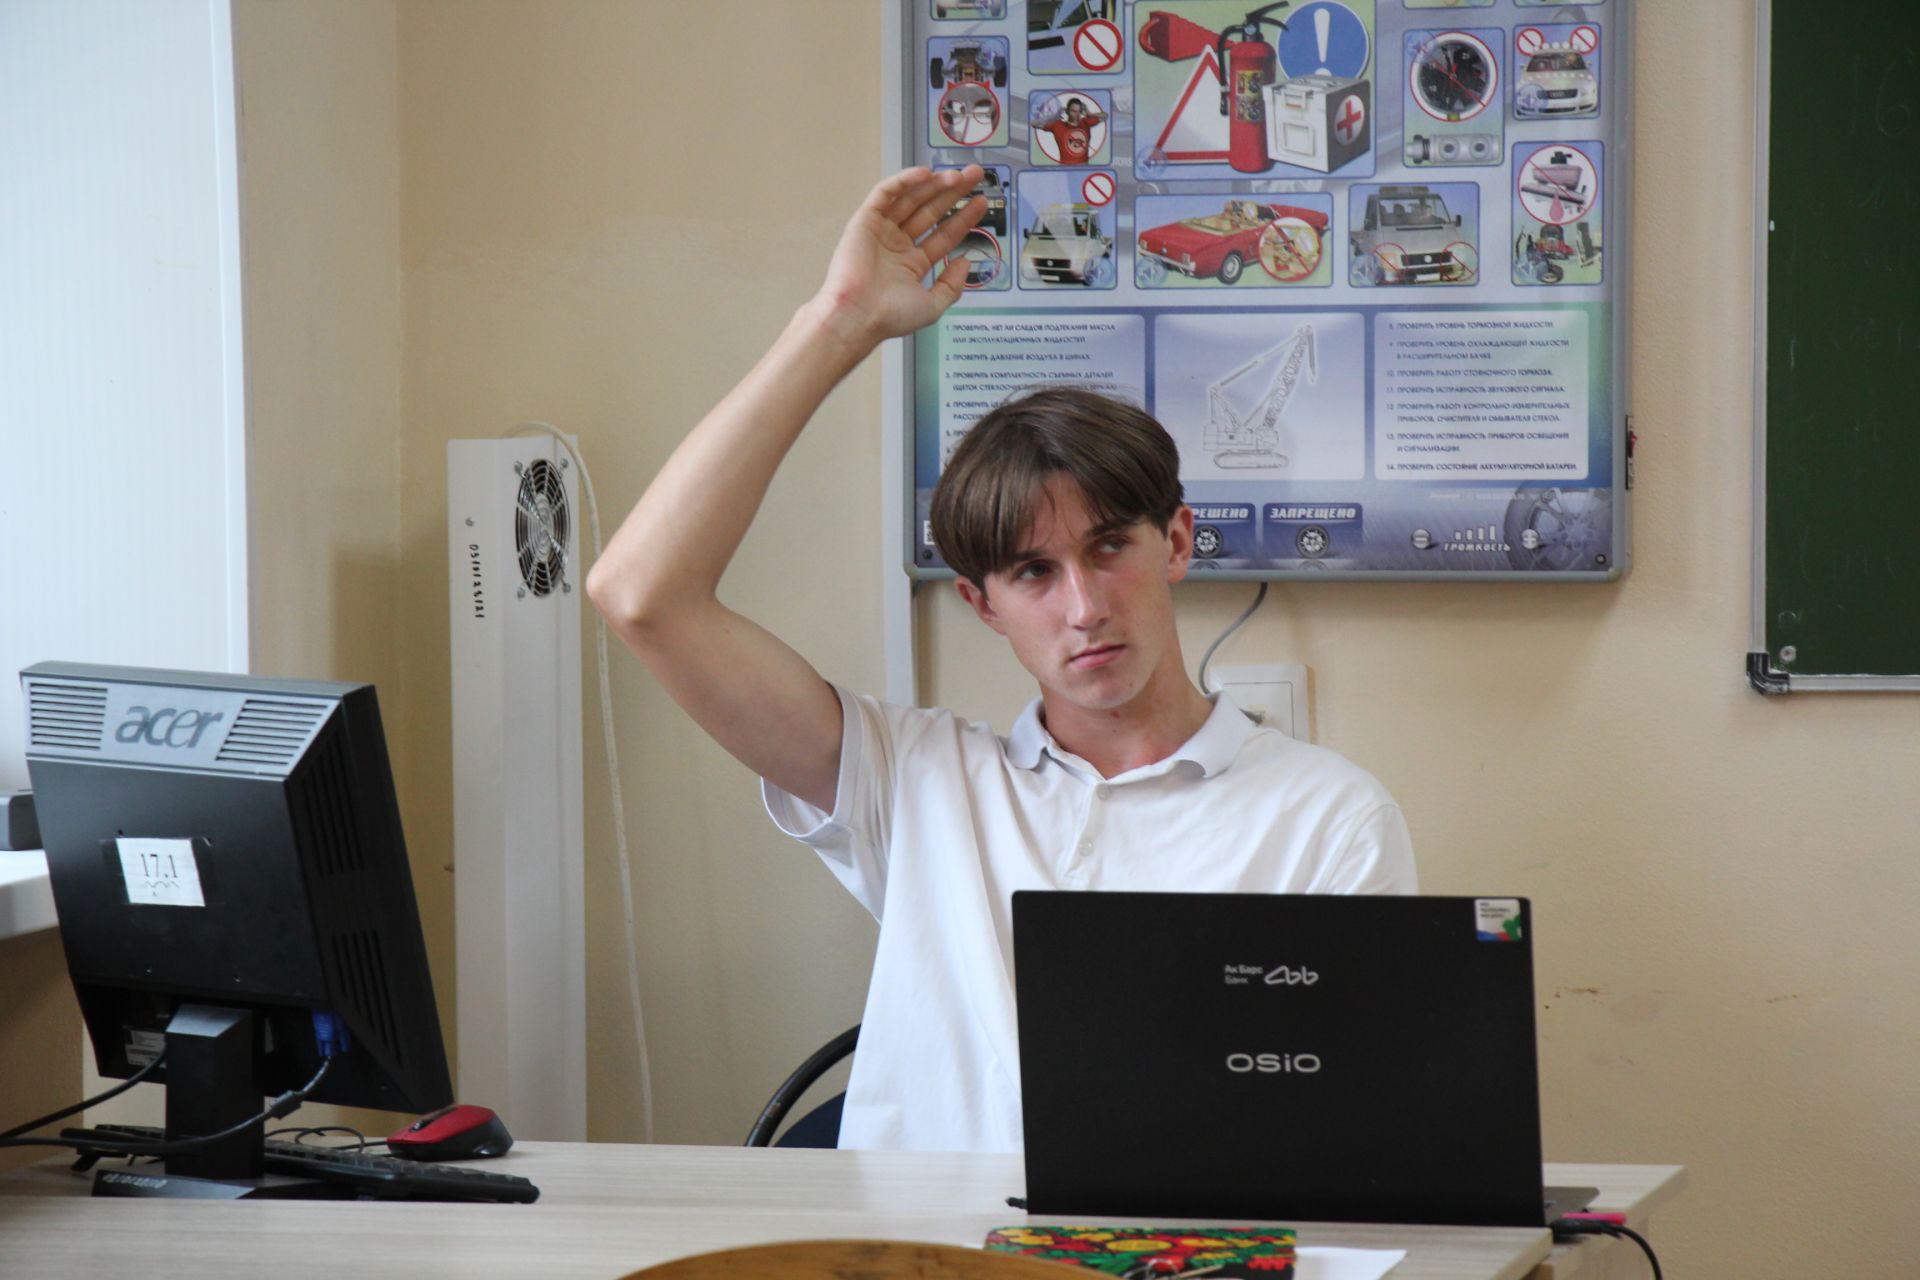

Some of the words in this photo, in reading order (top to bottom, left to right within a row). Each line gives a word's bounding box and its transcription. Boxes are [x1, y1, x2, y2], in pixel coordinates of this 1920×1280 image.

[1191, 507, 1249, 519] РЕШЕНО
[1269, 507, 1356, 520] ЗАПРЕЩЕНО
[1444, 543, 1511, 551] ГРОМКОСТЬ
[115, 705, 224, 748] acer
[140, 853, 178, 878] 17.1
[1224, 964, 1238, 974] Ак
[1239, 964, 1264, 975] Барс
[1224, 975, 1249, 984] Банк
